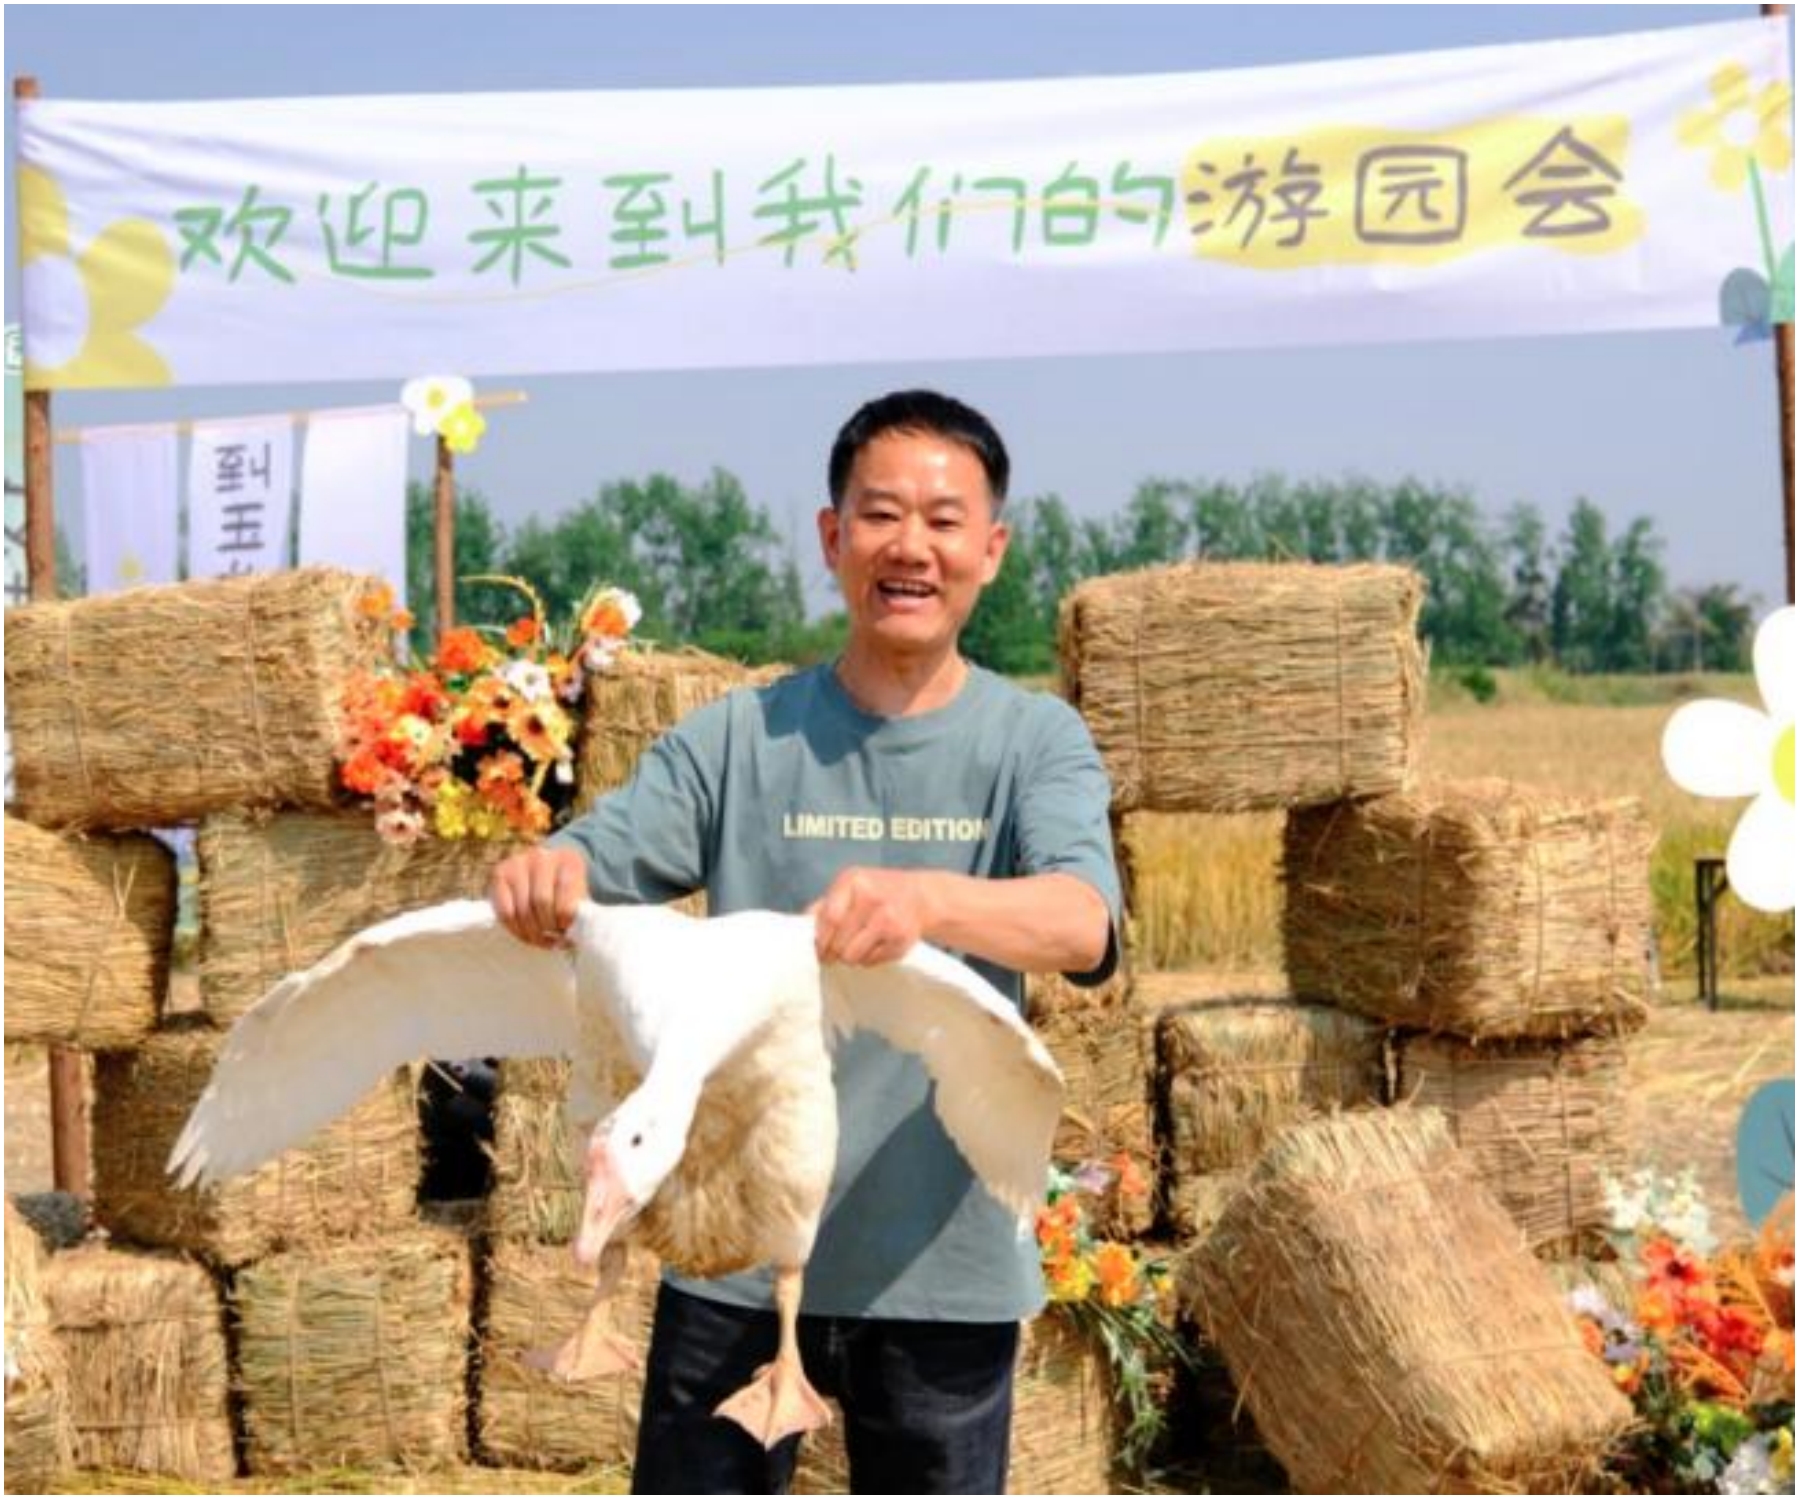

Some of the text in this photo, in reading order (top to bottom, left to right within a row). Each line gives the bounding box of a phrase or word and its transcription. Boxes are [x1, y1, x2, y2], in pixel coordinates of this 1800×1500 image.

[174, 127, 1624, 285] 欢迎来到我们的游园会
[783, 813, 990, 842] LIMITED EDITION
